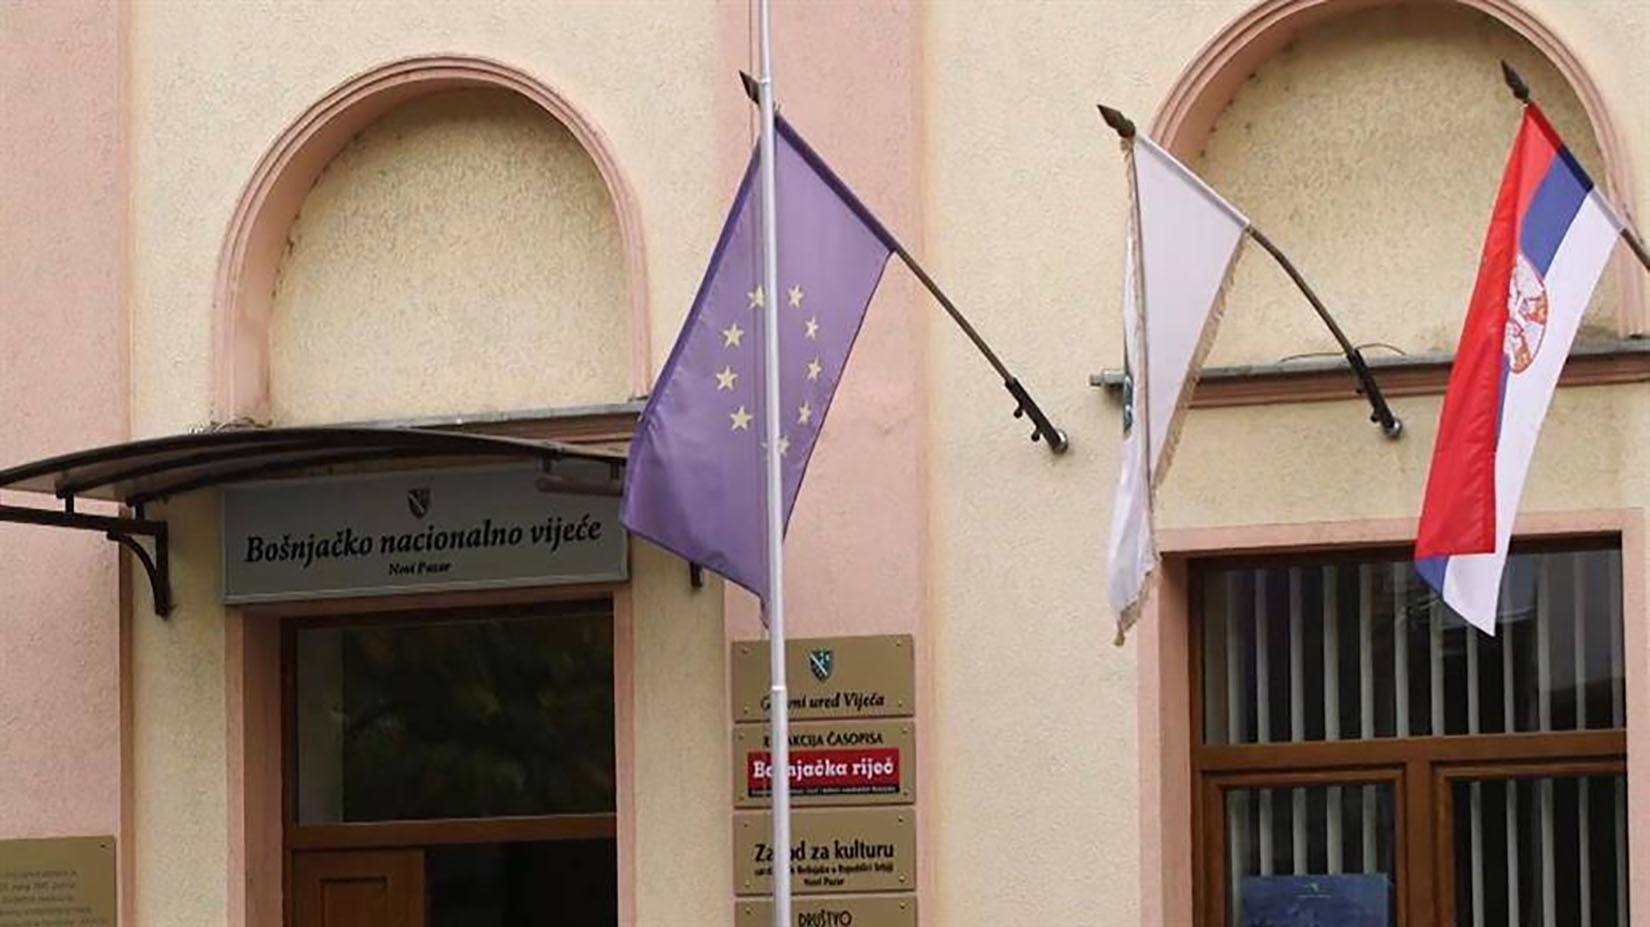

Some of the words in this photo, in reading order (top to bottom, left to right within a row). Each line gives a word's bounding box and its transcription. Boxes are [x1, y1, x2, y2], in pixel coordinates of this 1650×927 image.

[245, 528, 373, 568] Bošnjačko
[380, 519, 523, 554] nacionalno
[531, 513, 602, 552] vijeće
[388, 563, 417, 576] Novi
[418, 561, 451, 573] Pazar
[809, 692, 840, 709] ured
[844, 692, 885, 711] Vijeća
[827, 731, 884, 746] ČASOPISA
[852, 757, 895, 780] riječ
[811, 846, 830, 860] za
[834, 840, 895, 860] kulturu
[798, 909, 853, 927] DRUŠTVO
